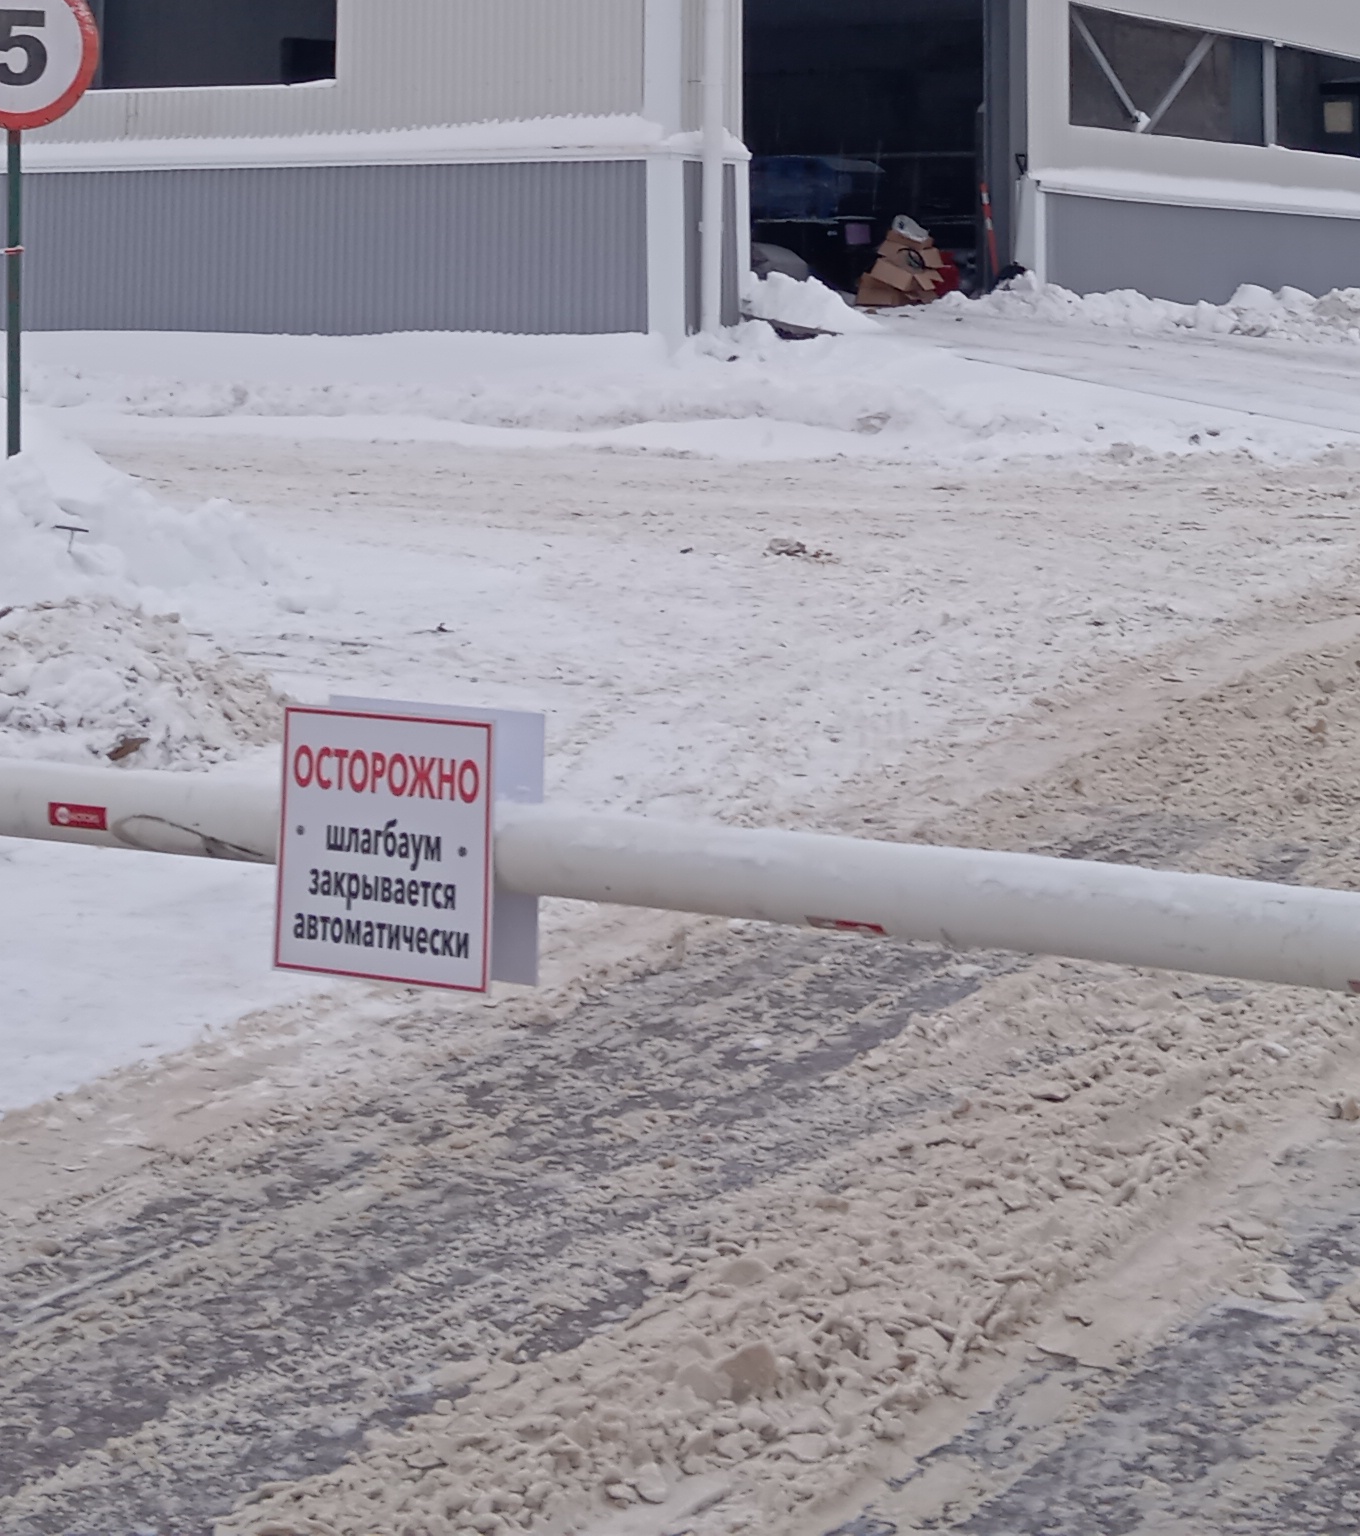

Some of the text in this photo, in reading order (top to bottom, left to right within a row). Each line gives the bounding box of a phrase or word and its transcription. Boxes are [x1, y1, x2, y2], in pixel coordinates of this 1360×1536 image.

[293, 744, 480, 804] ОСТОРОЖНО
[326, 818, 442, 872] шлагбаум
[307, 867, 457, 911] закрывается
[293, 912, 470, 960] автоматически
